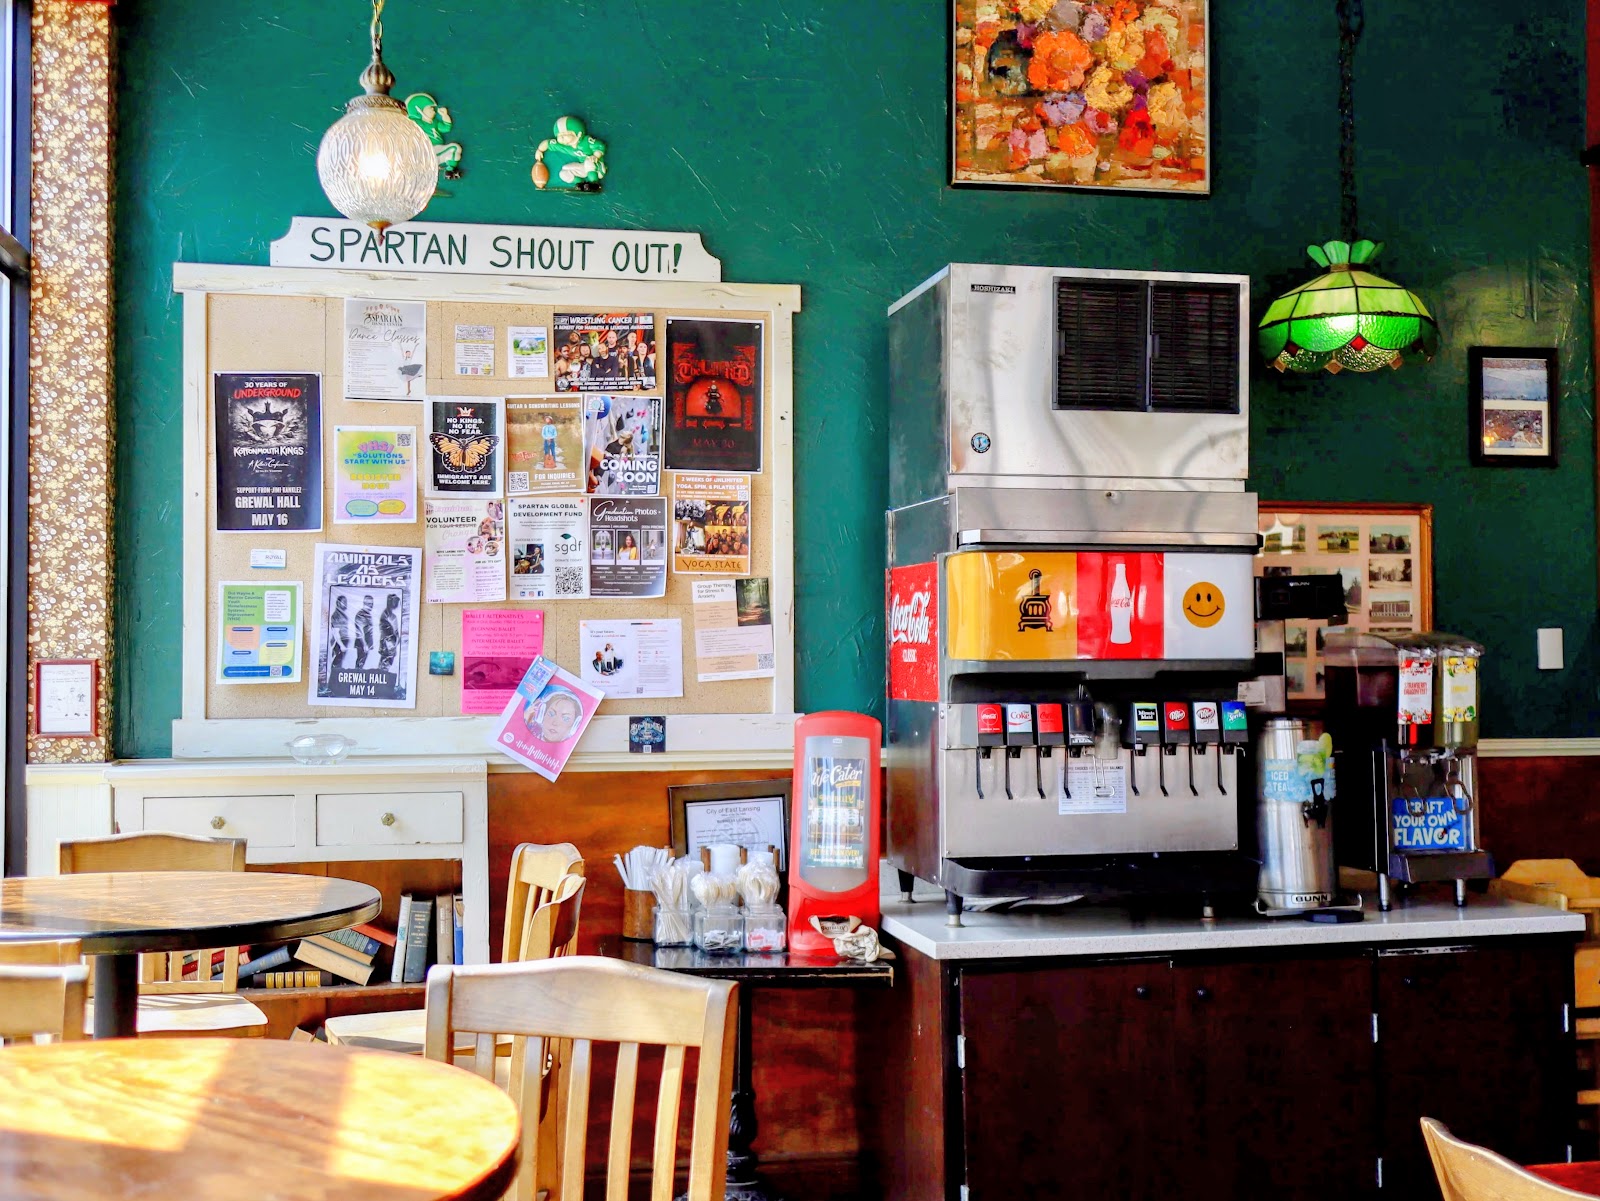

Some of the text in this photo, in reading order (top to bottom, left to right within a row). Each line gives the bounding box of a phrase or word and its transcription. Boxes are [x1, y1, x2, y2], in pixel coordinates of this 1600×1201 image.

[310, 226, 683, 274] SPARTAN SHOUT OUT!
[973, 285, 1014, 293] HOSHIZAKI
[569, 316, 606, 324] WRESTLING
[607, 316, 633, 324] CANCER
[349, 328, 378, 340] Dance
[233, 388, 302, 400] UNDERGROUND
[233, 446, 304, 458] KOTTONMOUTH KINGS
[600, 459, 658, 472] COMING
[547, 472, 576, 480] INQUIRIES
[616, 472, 657, 482] SOON
[236, 486, 257, 494] SUPPORT
[258, 486, 270, 494] FROM
[235, 496, 301, 509] GREWAL HALL
[252, 514, 289, 526] MAY 16
[426, 516, 477, 524] VOLUNTEER
[554, 540, 582, 555] sgdf
[326, 552, 409, 566] ANIMALS
[682, 560, 741, 570] YOGA STATE
[356, 564, 379, 575] AS
[326, 574, 406, 587] LEADERS
[890, 591, 931, 645] Coca-Cola
[338, 672, 388, 684] GREWAL HALL
[350, 684, 375, 696] MAY 14
[1010, 712, 1030, 720] Coke
[812, 762, 863, 786] We Cater
[1271, 770, 1288, 781] ICED
[1272, 782, 1287, 792] TEA
[1394, 809, 1458, 828] YOUR OWN
[1394, 828, 1461, 846] FLAVOR
[1295, 894, 1329, 902] BUNN
